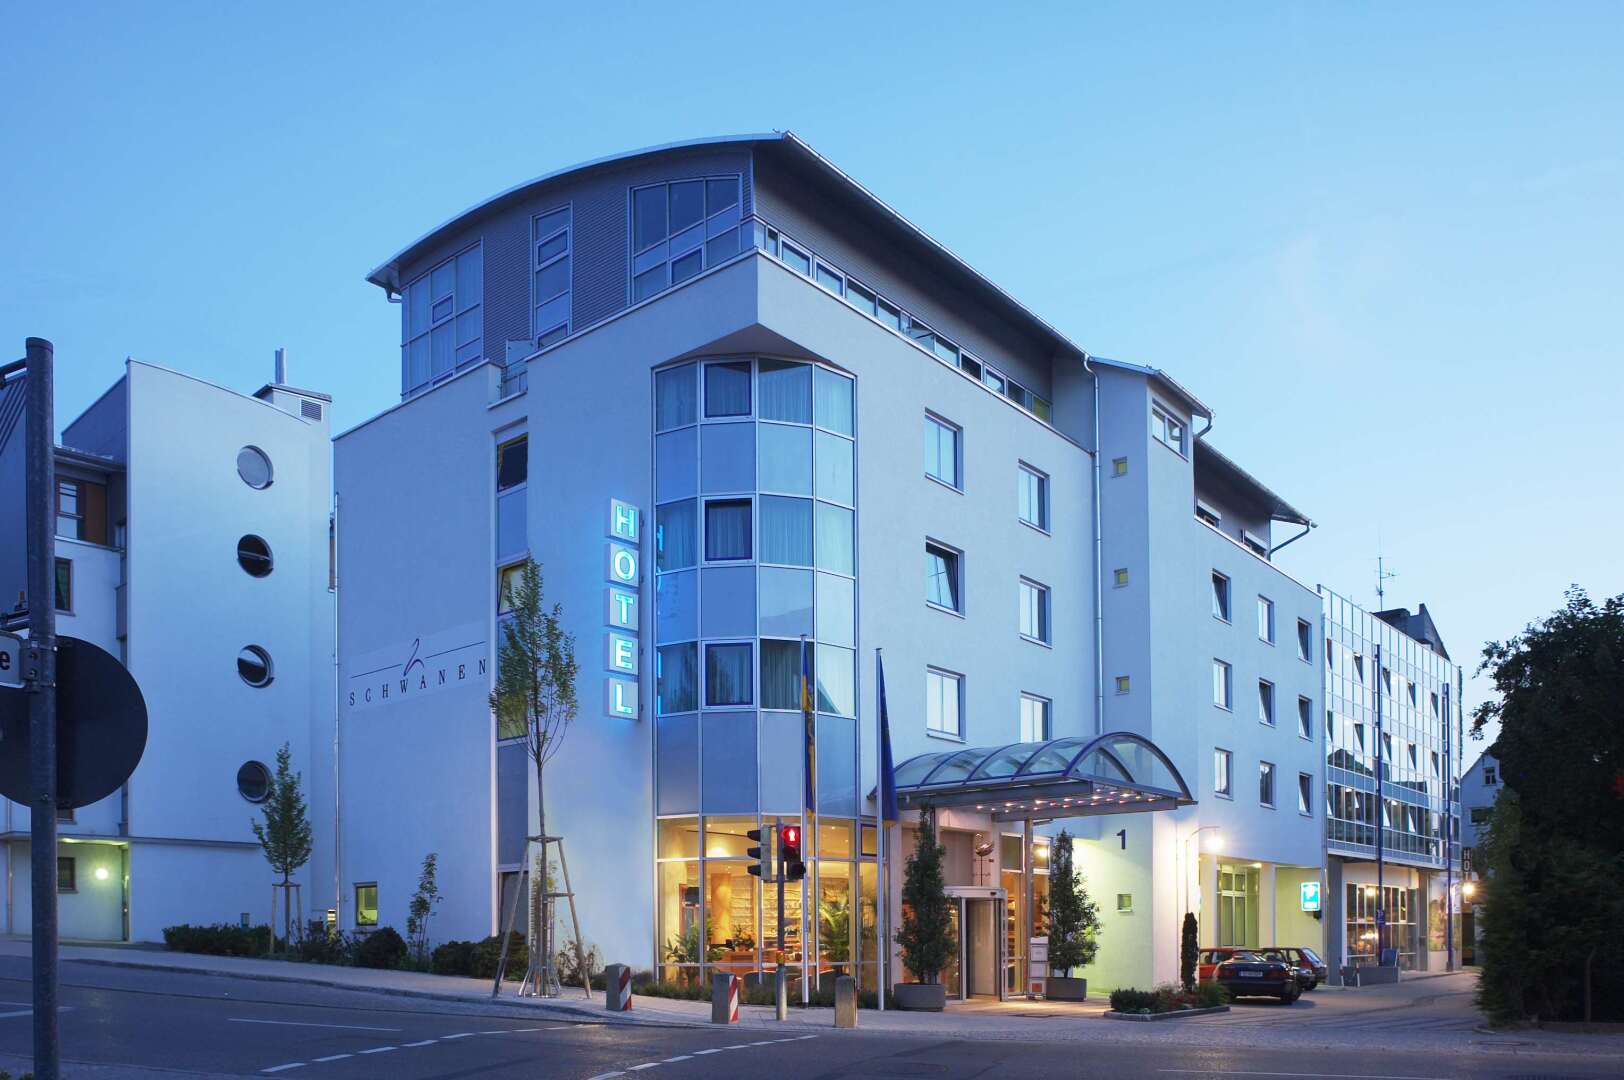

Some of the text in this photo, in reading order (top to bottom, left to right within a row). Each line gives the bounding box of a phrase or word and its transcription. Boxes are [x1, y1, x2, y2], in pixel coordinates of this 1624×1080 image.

[614, 504, 636, 714] HOTEL
[349, 658, 487, 706] SCHWANEN
[1116, 828, 1126, 850] 1
[1463, 849, 1471, 904] HOTL
